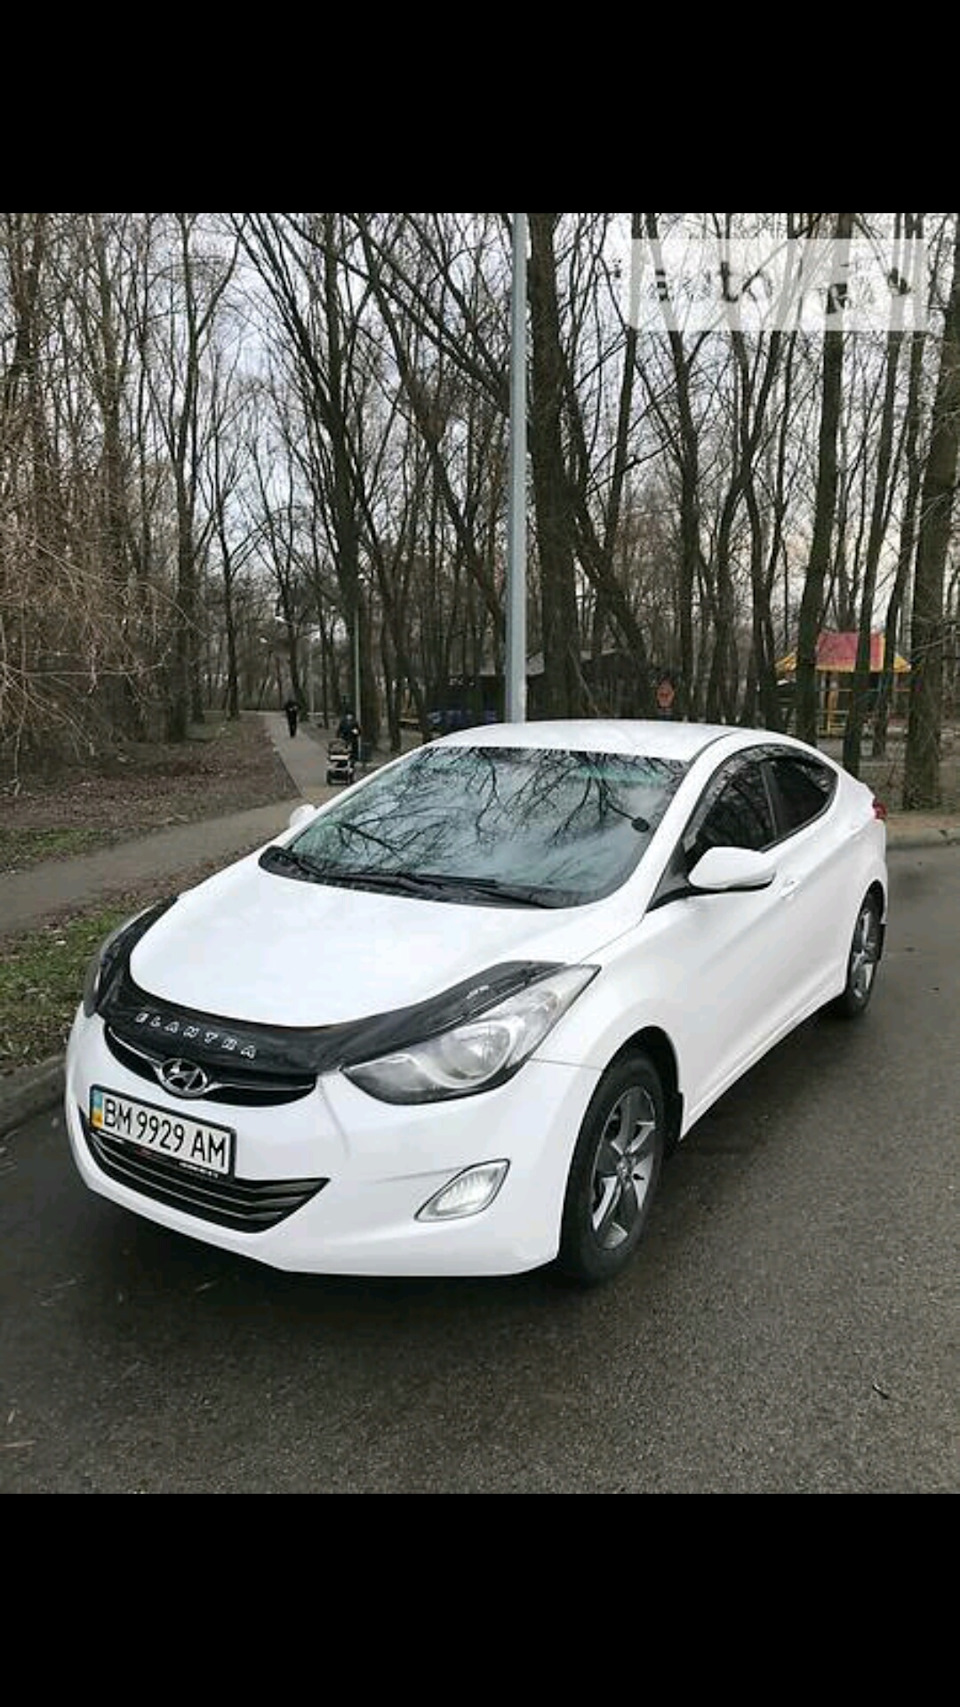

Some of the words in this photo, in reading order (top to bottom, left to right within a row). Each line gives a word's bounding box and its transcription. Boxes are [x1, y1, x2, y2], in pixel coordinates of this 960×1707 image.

[135, 1013, 256, 1058] ELANTRA
[105, 1099, 132, 1135] BM
[137, 1112, 184, 1152] 9929
[191, 1130, 226, 1168] AM
